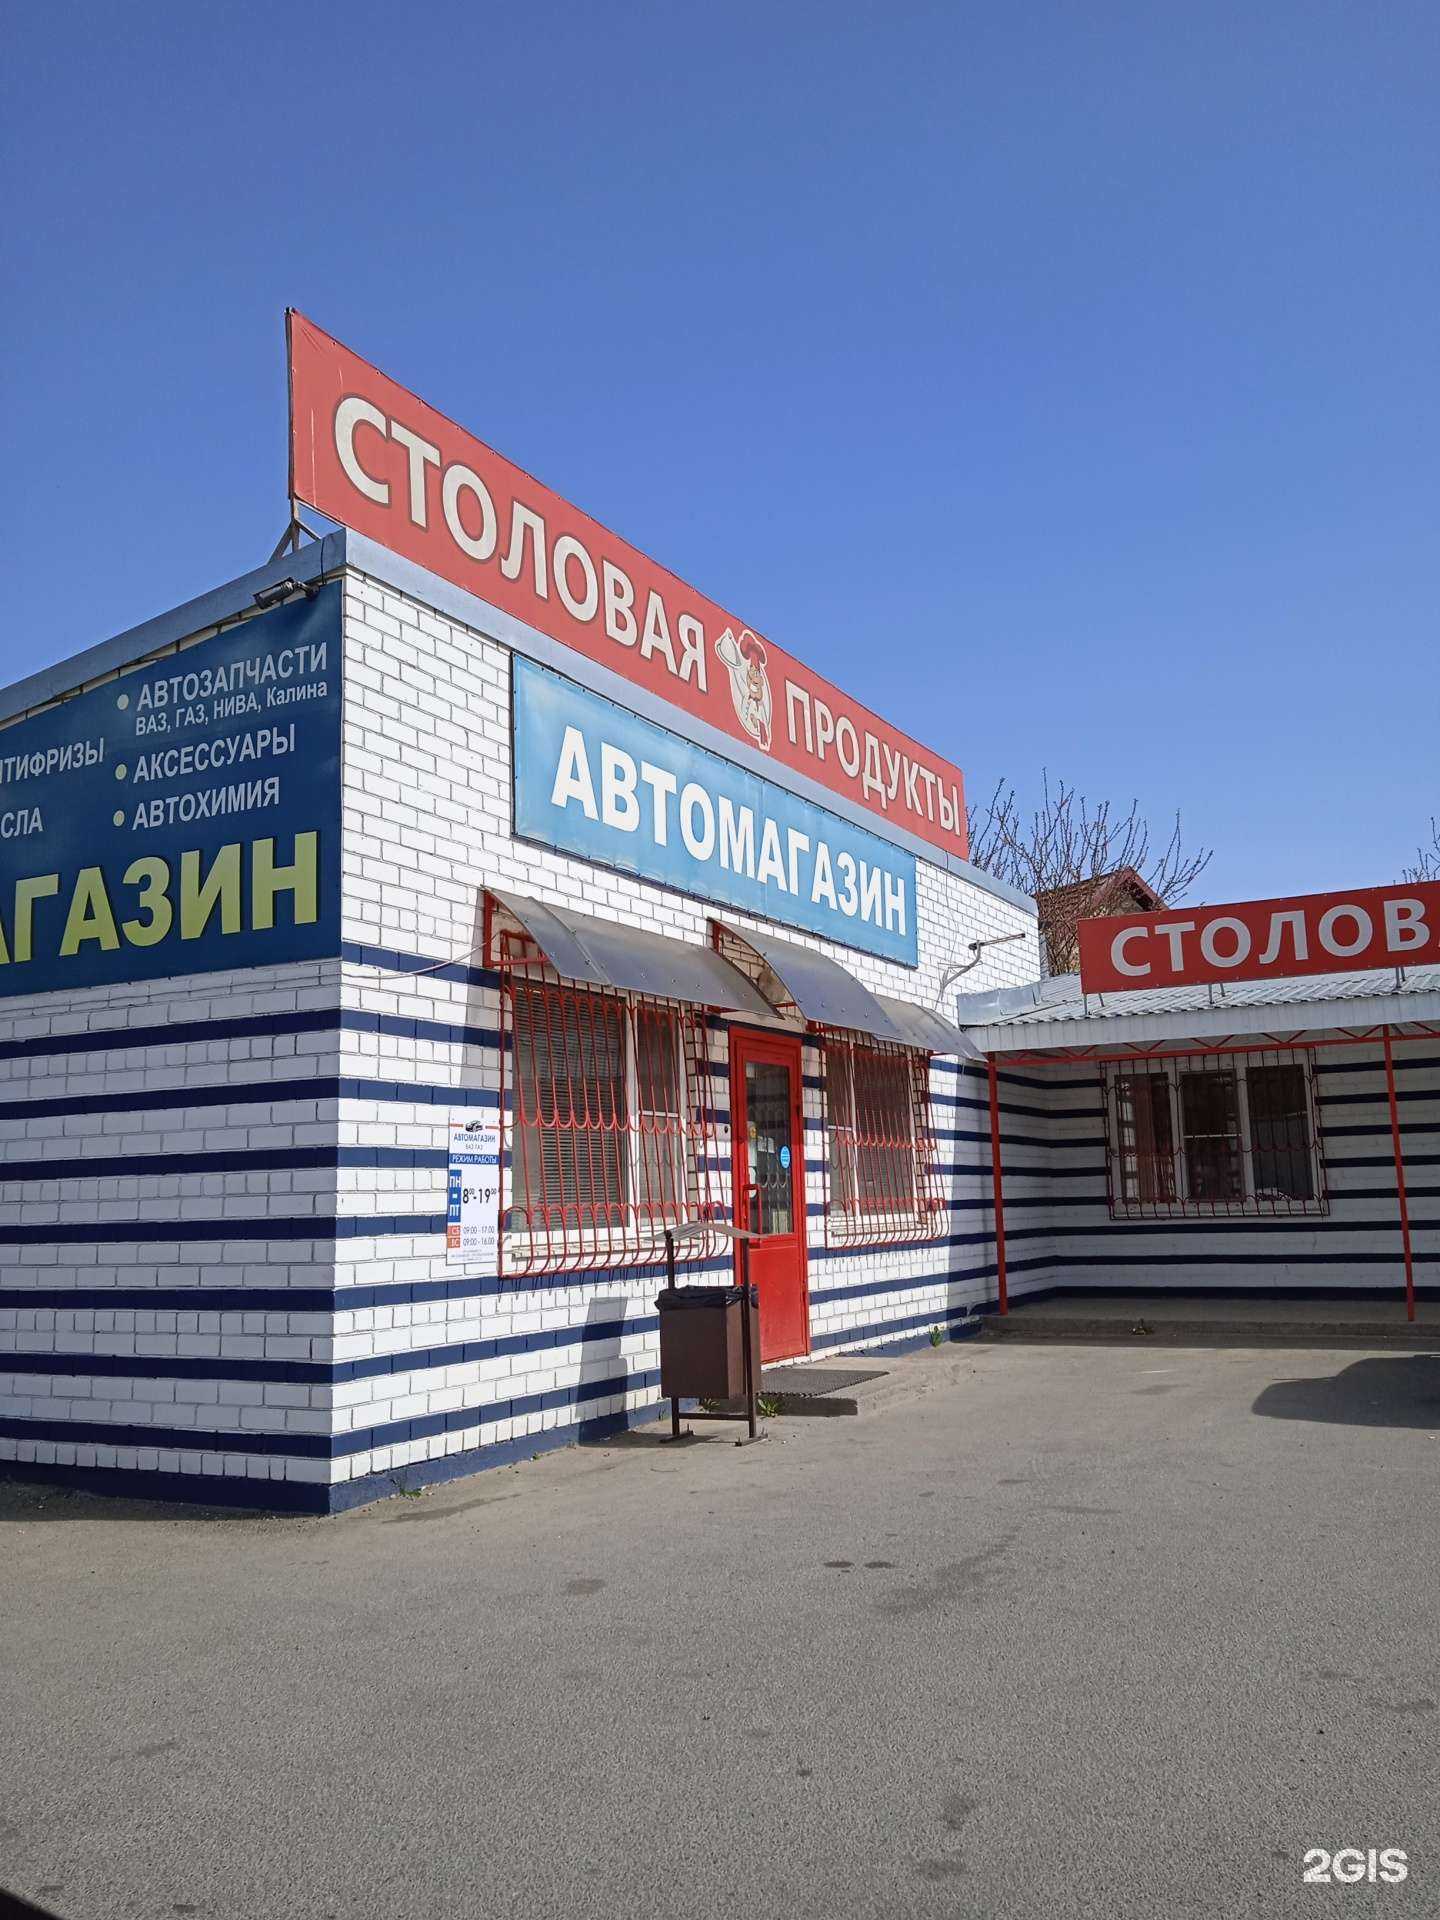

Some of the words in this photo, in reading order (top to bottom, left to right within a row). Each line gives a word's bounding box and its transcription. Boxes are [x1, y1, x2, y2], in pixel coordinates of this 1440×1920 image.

[335, 396, 708, 693] СТОЛОВАЯ
[785, 679, 961, 836] ПРОДУКТЫ
[137, 642, 327, 711] АВТОЗАПЧАСТИ
[136, 713, 171, 736] ВАЗ,
[176, 704, 208, 727] ГАЗ,
[213, 692, 261, 720] НИВА,
[267, 681, 327, 708] Калина
[0, 738, 104, 784] ТИФРИЗЫ
[133, 724, 295, 784] АКСЕССУАРЫ
[132, 777, 280, 831] АВТОХИМИЯ
[551, 726, 907, 936] АВТОМАГАЗИН
[0, 831, 317, 965] ГАЗИН
[1110, 898, 1440, 977] СТОЛОВ
[452, 1154, 474, 1163] РЕЖИМ
[474, 1155, 497, 1164] РАБОТЫ
[454, 1133, 496, 1143] АВТОМАГАЗИН
[449, 1176, 461, 1188] ПН
[449, 1204, 460, 1216] ПТ
